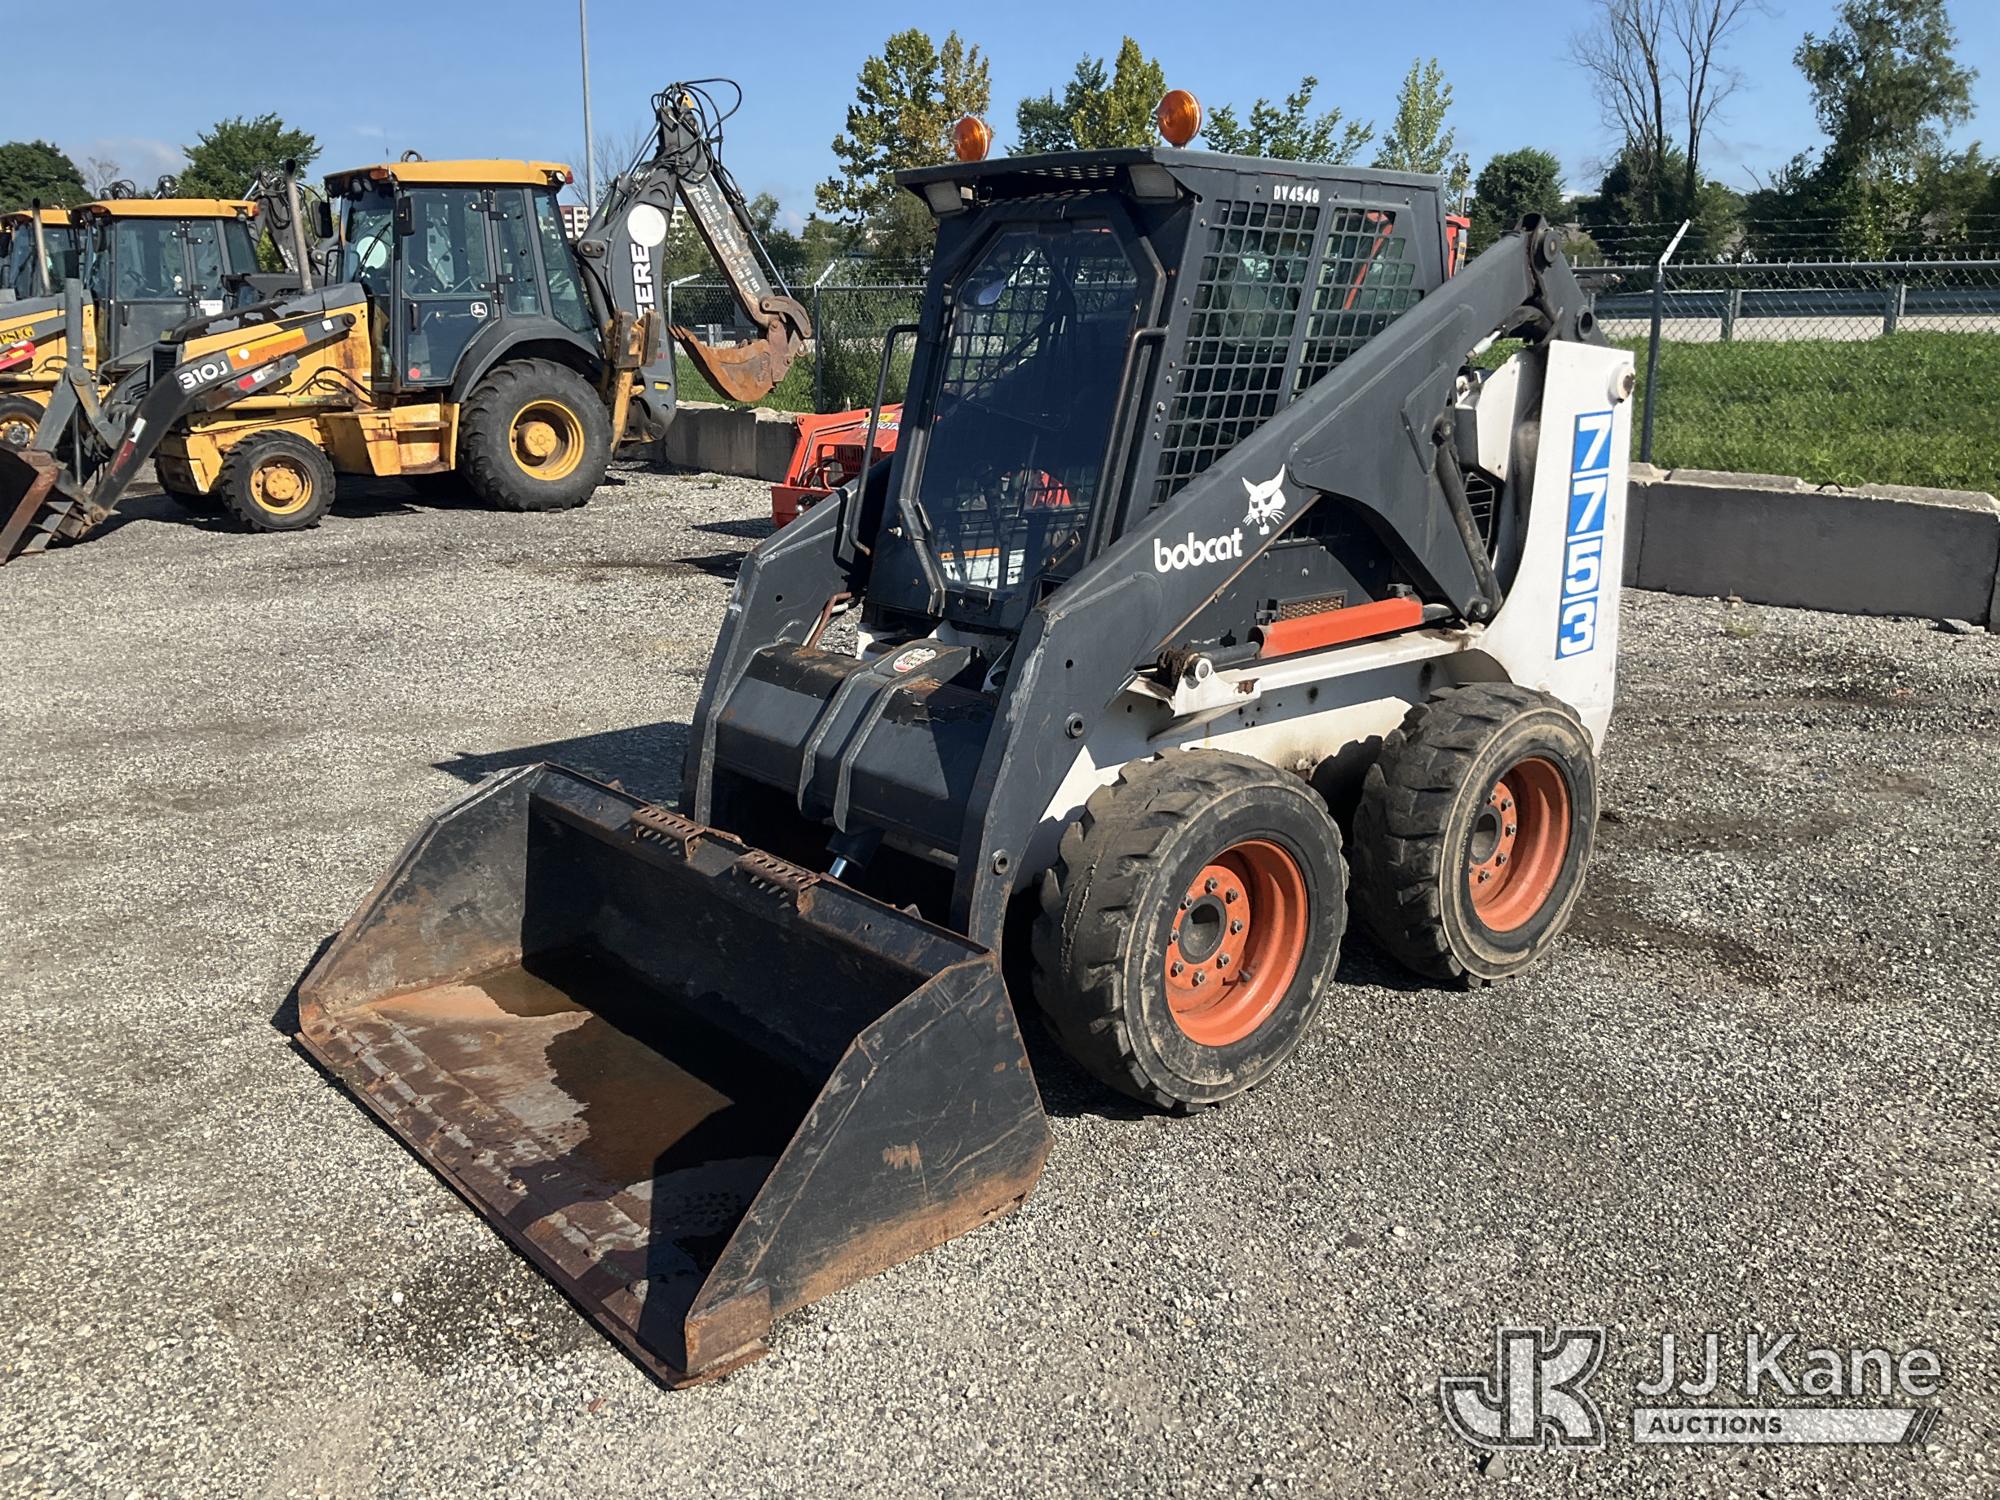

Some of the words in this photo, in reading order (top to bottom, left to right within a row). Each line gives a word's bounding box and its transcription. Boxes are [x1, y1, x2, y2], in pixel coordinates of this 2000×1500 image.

[179, 361, 228, 389] 310J
[1154, 527, 1243, 573] bobcat
[1560, 413, 1612, 656] 7753
